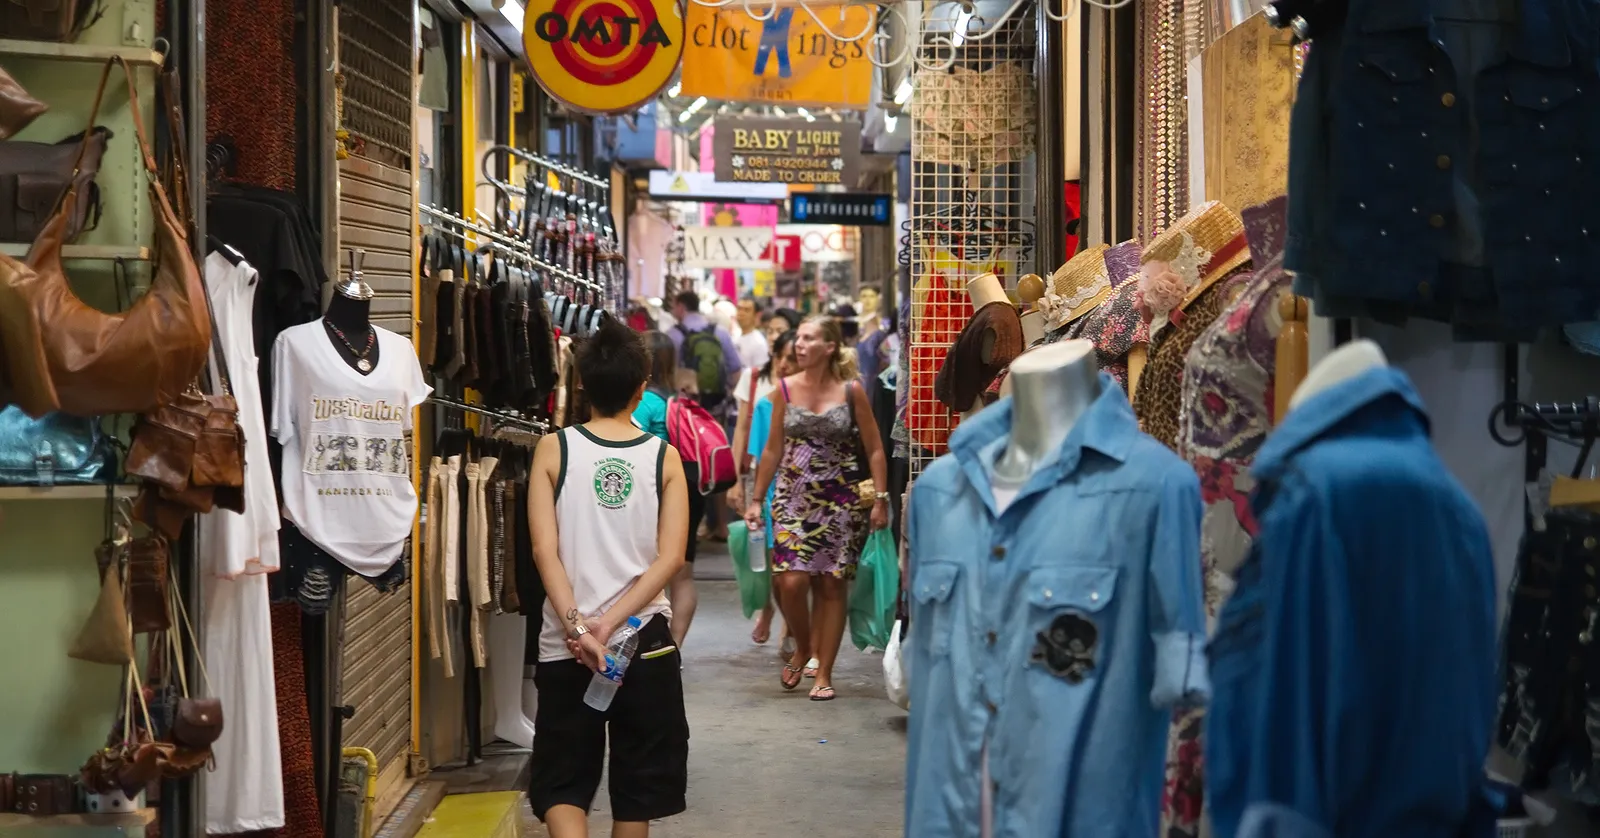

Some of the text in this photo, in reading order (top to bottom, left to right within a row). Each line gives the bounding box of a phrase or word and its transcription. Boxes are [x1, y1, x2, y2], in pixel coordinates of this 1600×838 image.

[534, 12, 672, 48] OMTA
[733, 129, 841, 149] BABY LIGHT
[732, 169, 842, 183] MADE TO ORDER
